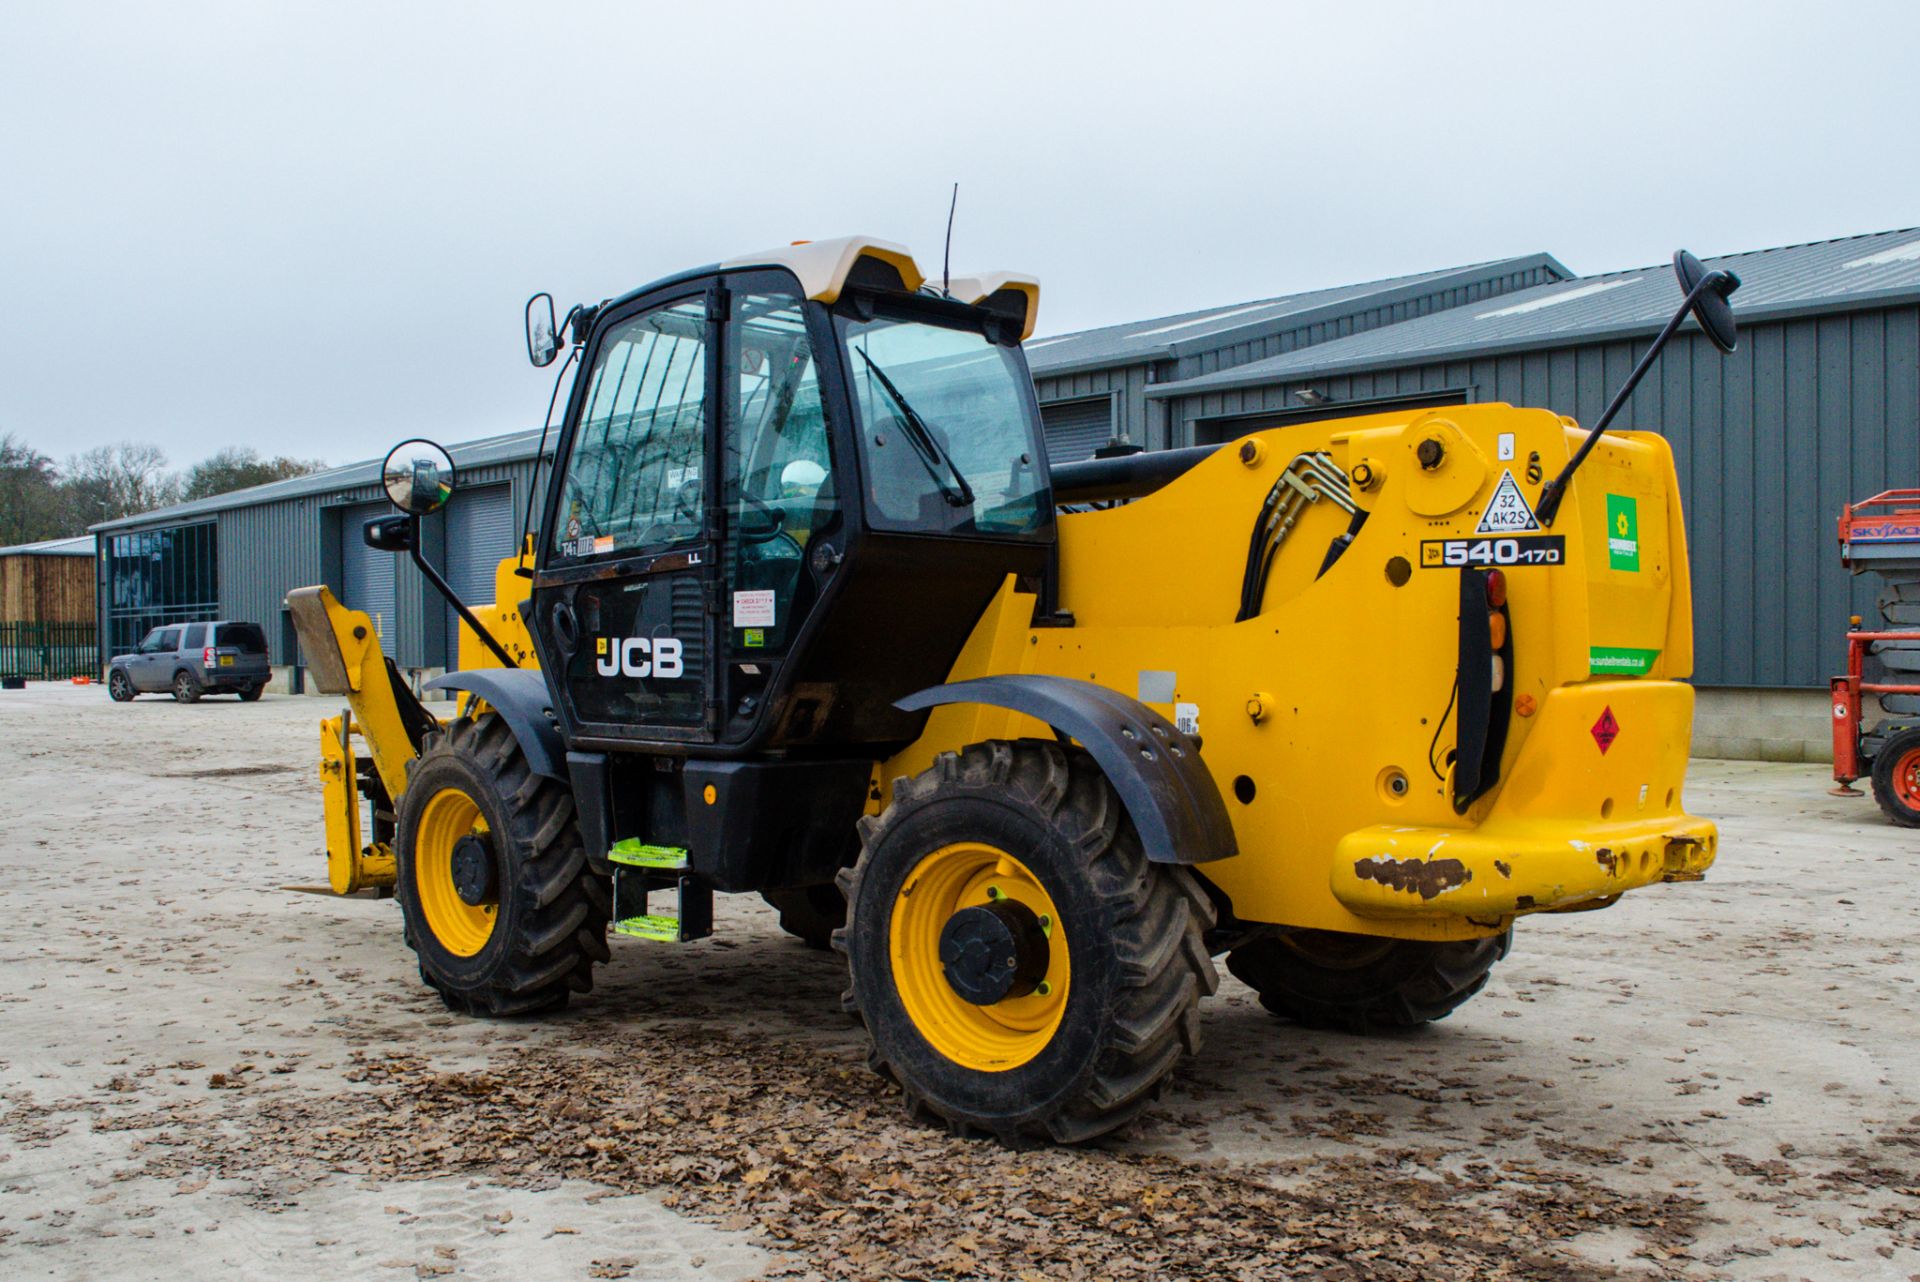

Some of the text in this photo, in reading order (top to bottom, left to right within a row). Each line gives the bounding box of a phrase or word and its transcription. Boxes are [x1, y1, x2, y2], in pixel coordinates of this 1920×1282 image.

[1500, 495, 1515, 508] 32
[1492, 510, 1526, 525] AK2S
[688, 552, 701, 564] LL
[597, 637, 683, 678] JCB
